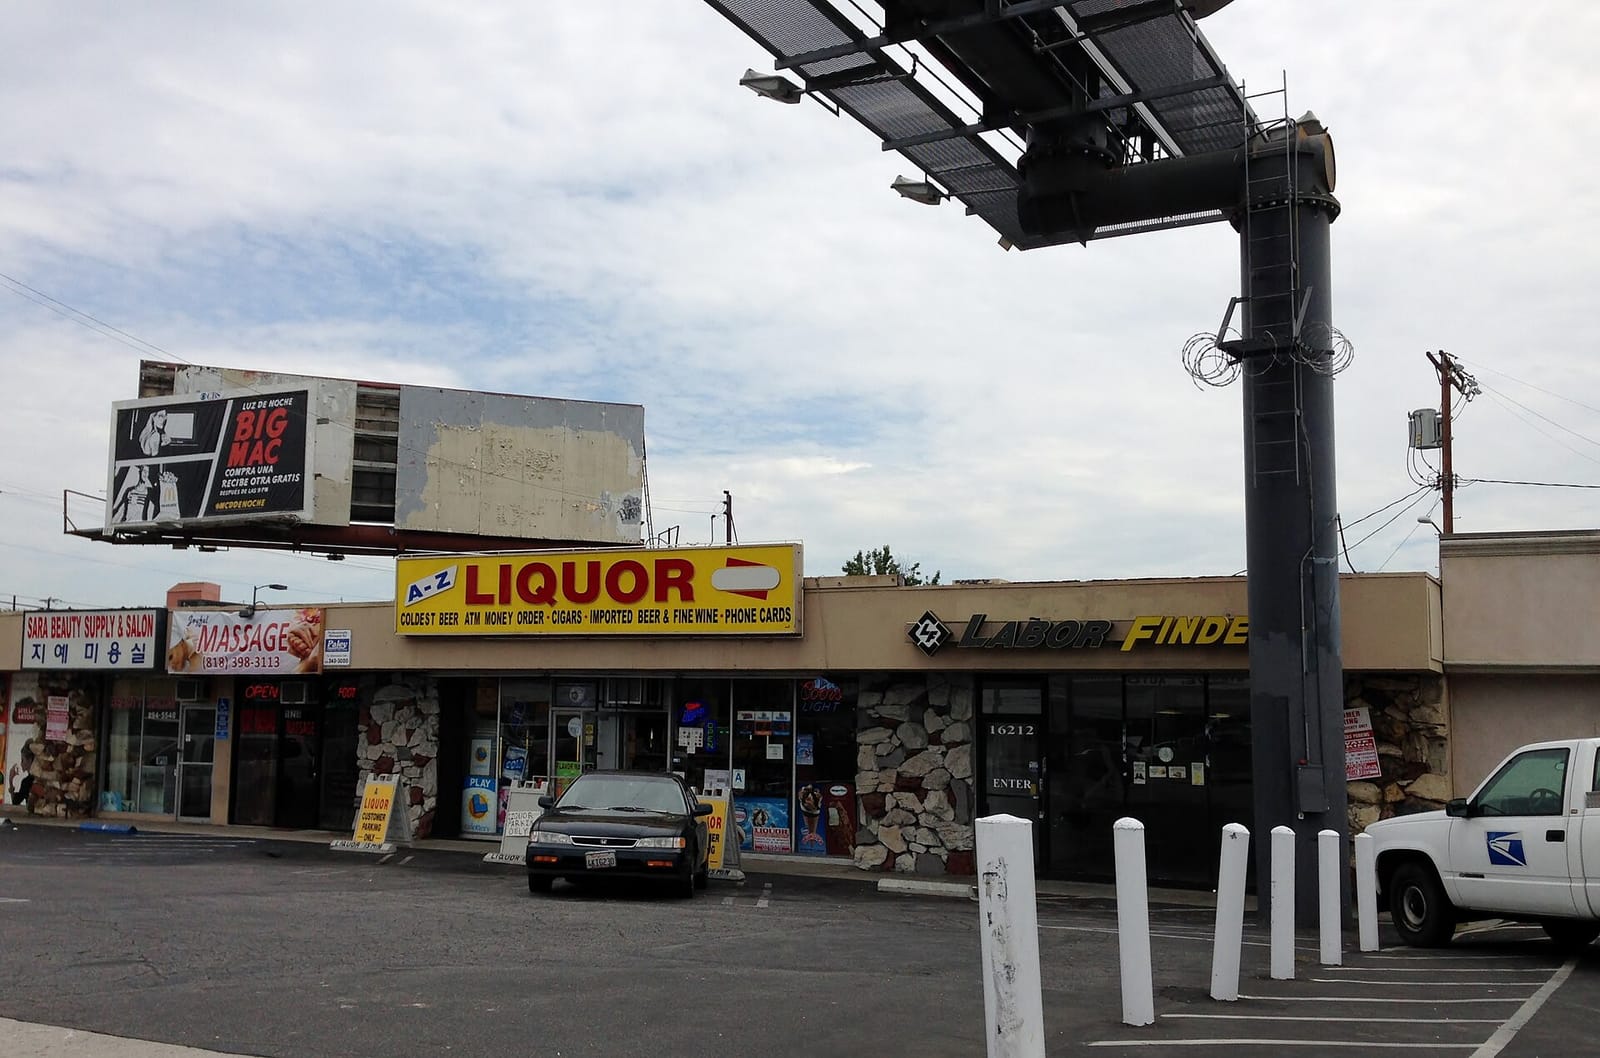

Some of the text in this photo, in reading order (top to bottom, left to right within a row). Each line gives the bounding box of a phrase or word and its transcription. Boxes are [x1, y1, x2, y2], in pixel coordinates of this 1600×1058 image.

[242, 397, 294, 410] LUZ DE NOCHE
[234, 407, 289, 442] BIG
[227, 438, 283, 468] MAC
[224, 465, 274, 477] COMPRA UNA
[221, 473, 301, 488] RECIBE OTRA GRATIS
[408, 571, 451, 602] A-Z
[465, 558, 696, 607] LIQUOR
[400, 606, 791, 626] COLDEST BEER ATM MONEY ORDER CIGARS IMPORTED BEER & FINE WINE PHONE CARDS
[27, 614, 154, 639] SARA BEAUTY SUPPLY & SALON
[957, 613, 1113, 648] LABOR
[196, 622, 290, 652] MASSAGE
[202, 655, 281, 671] (818) 398-3113
[245, 684, 280, 699] OPEN
[338, 687, 357, 699] FOOT
[801, 702, 840, 712] LIGHT
[989, 725, 1035, 736] 16212
[469, 777, 491, 787] PLAY
[735, 773, 743, 782] A
[993, 778, 1032, 790] ENTER
[364, 798, 389, 810] LIQUOR
[362, 812, 386, 822] CUSTOMER
[362, 823, 382, 832] PARKING
[754, 827, 788, 835] LIQUOR
[363, 833, 376, 842] ONLY
[490, 852, 520, 861] LIQUOR
